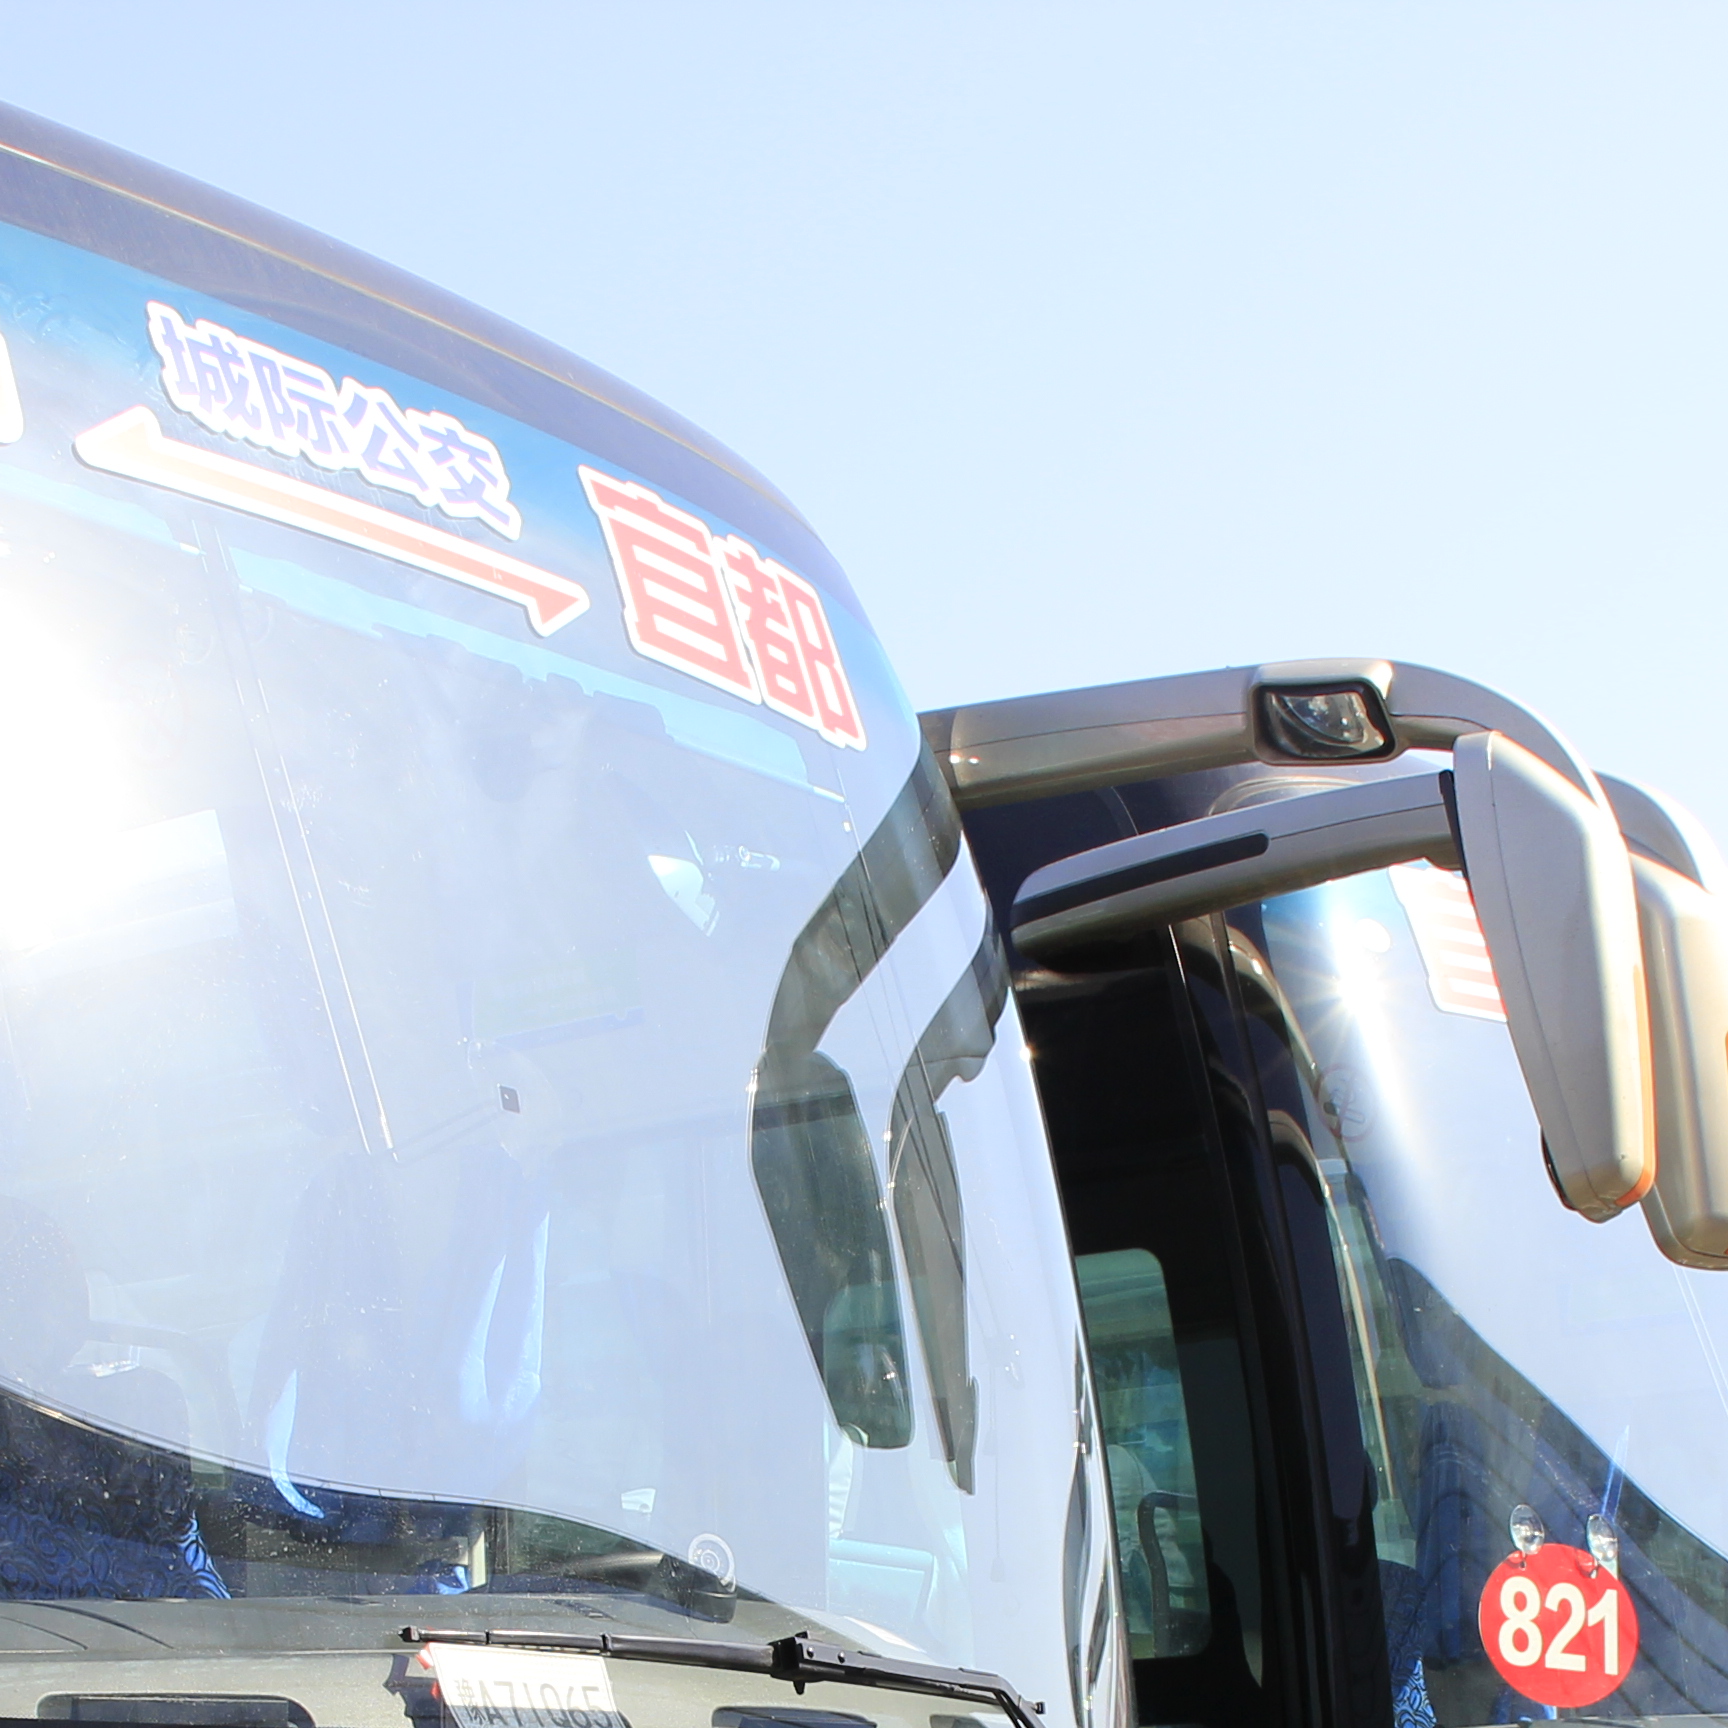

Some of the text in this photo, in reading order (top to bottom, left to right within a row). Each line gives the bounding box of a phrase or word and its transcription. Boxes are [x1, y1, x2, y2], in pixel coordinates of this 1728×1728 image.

[156, 313, 512, 528] 城际公交
[586, 477, 862, 742] 宜都
[1497, 1576, 1620, 1676] 821
